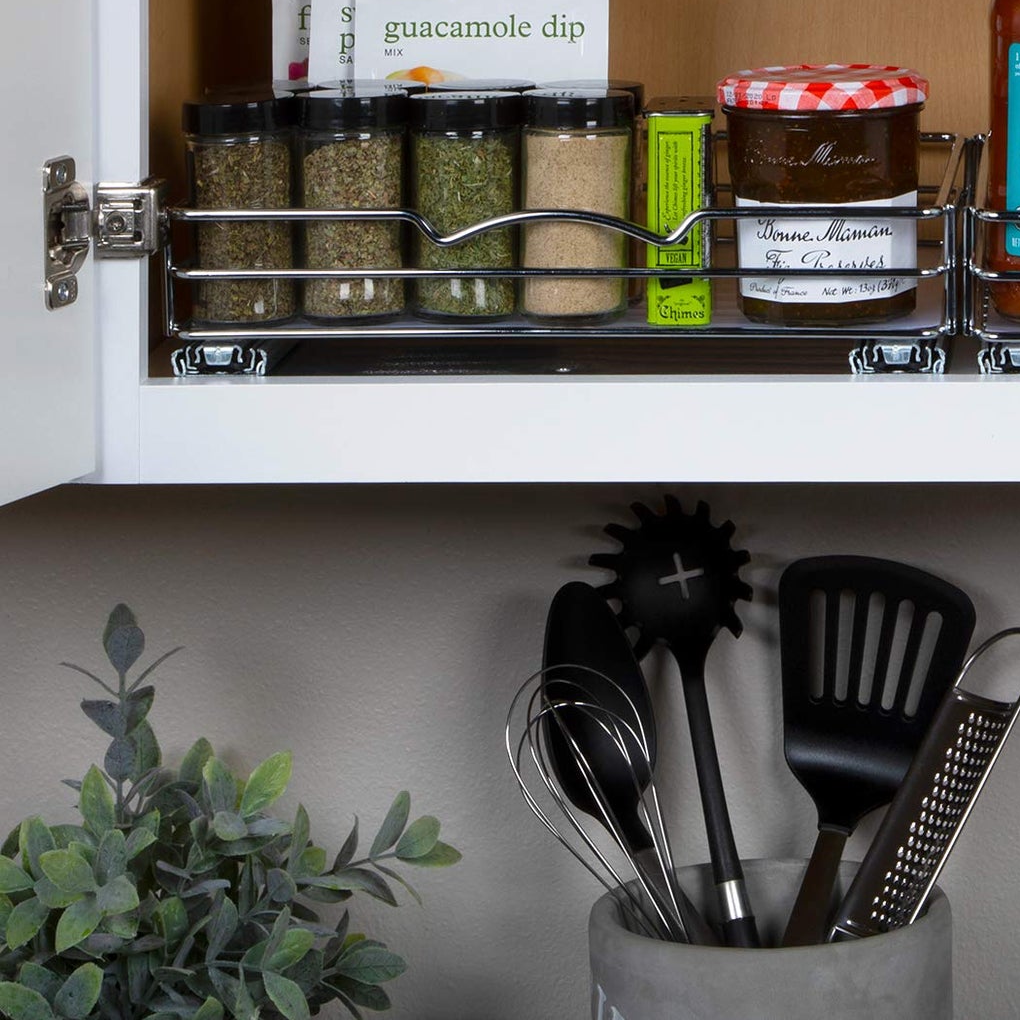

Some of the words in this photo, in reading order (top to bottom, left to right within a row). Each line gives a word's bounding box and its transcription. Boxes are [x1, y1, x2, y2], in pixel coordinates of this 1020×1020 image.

[384, 14, 532, 43] guacamole
[541, 14, 586, 44] dip
[384, 48, 404, 57] MIX
[665, 252, 687, 264] VEGAN
[658, 304, 706, 322] Chimes
